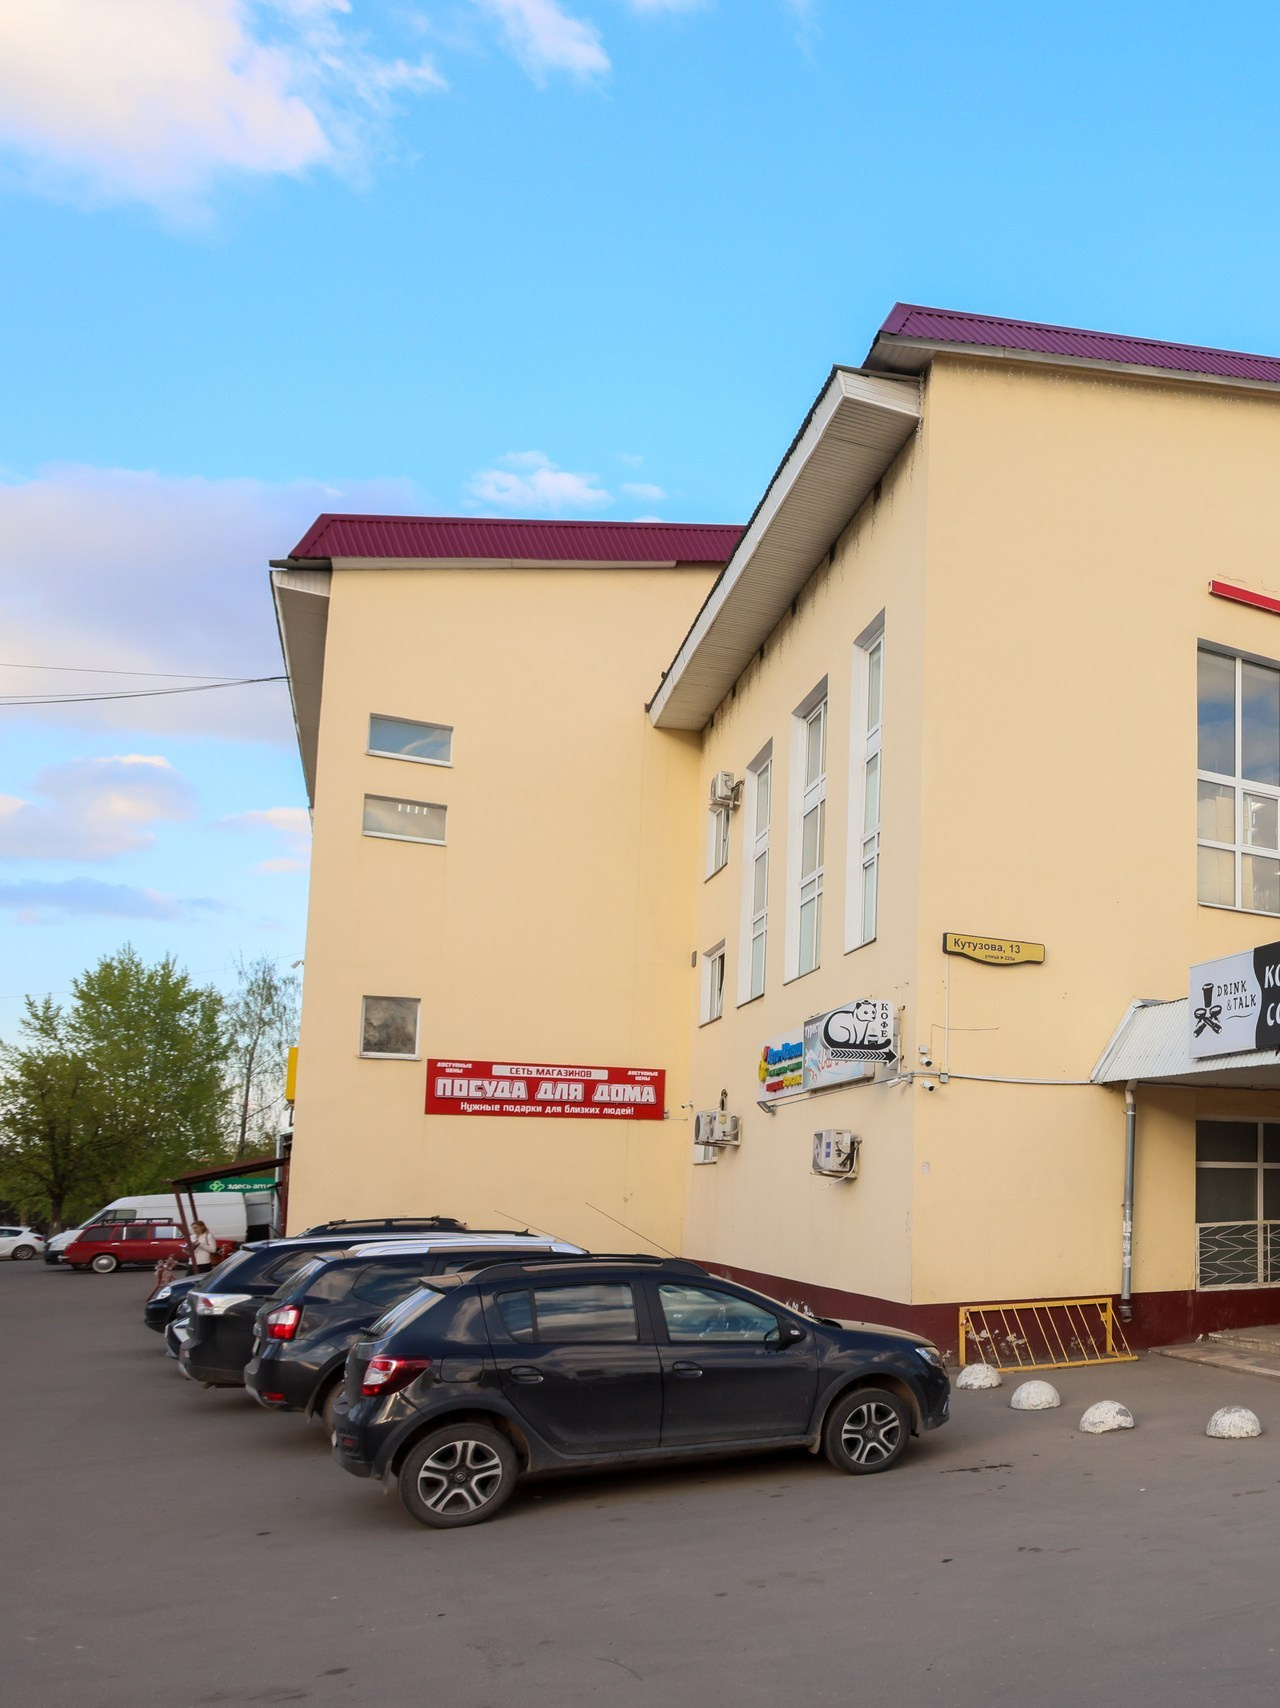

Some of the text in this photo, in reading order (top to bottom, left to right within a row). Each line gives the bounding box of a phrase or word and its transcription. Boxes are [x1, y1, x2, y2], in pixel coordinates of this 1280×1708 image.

[953, 937, 1021, 954] Кутузова, 13
[1217, 980, 1247, 997] DRINK
[880, 1003, 889, 1038] КОФЕ
[509, 1066, 592, 1078] СЕТЬ МАГАЗИНОВ
[435, 1077, 656, 1104] ПОСУДА ДЛЯ ДОМА
[460, 1101, 634, 1116] Нужные подарки для близких людей!
